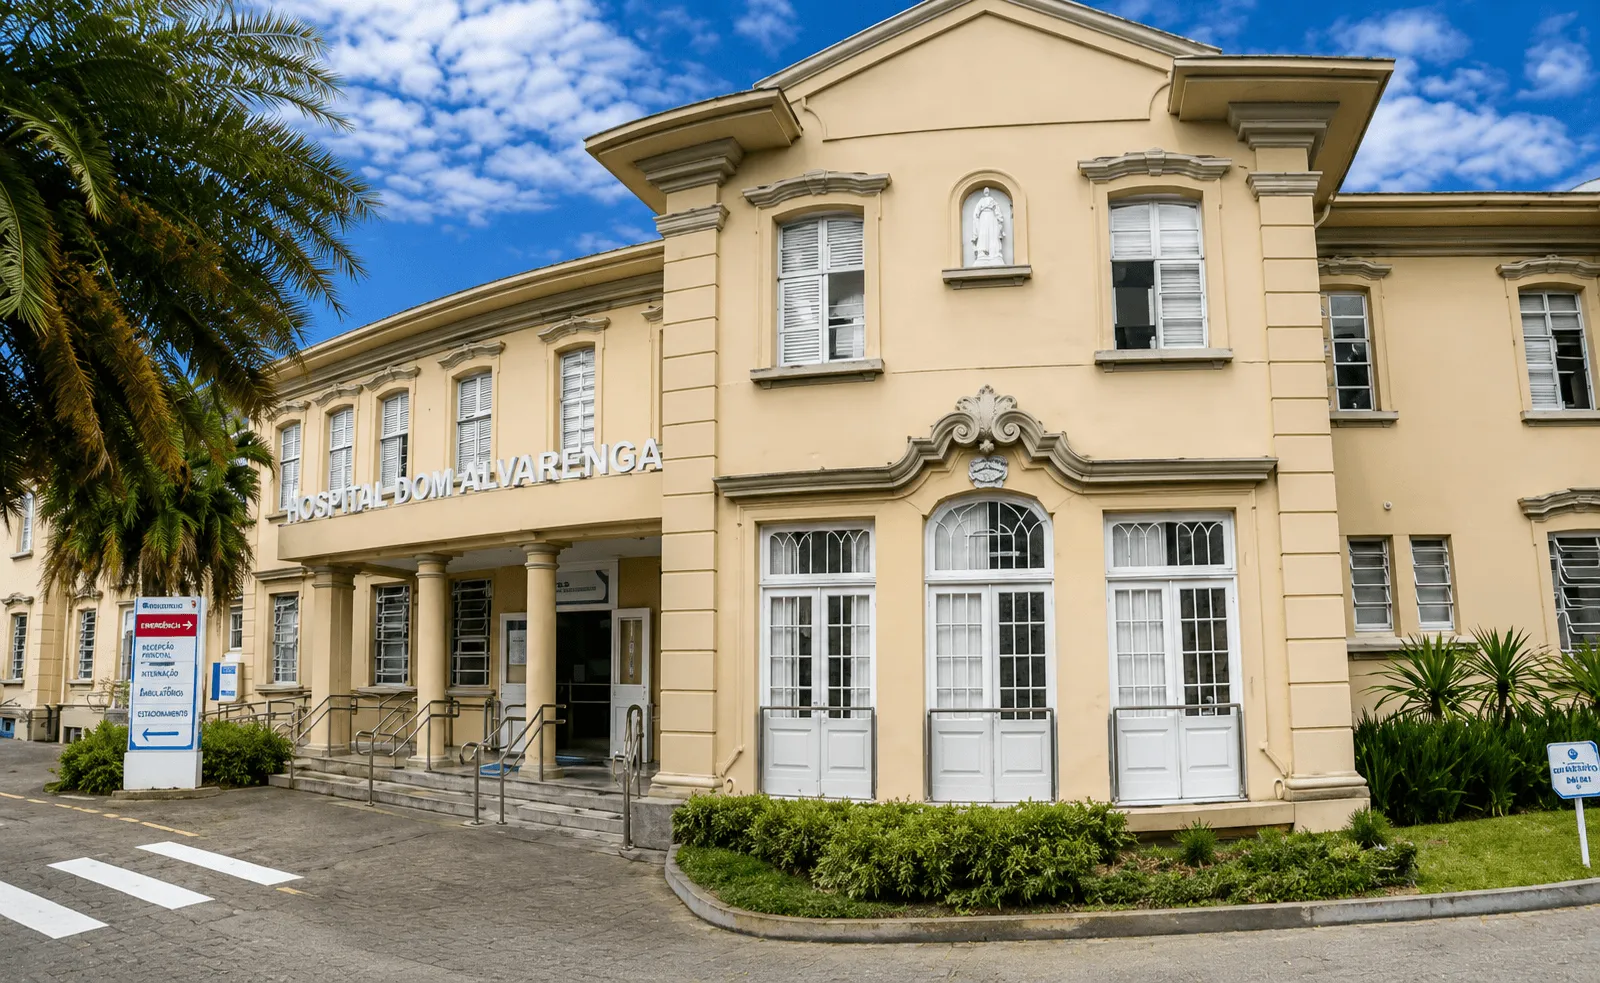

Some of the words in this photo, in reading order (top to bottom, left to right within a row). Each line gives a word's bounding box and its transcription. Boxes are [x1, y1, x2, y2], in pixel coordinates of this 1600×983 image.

[286, 481, 388, 523] HOSPITAL
[394, 467, 454, 504] DOM
[459, 438, 663, 494] ALVARENGA
